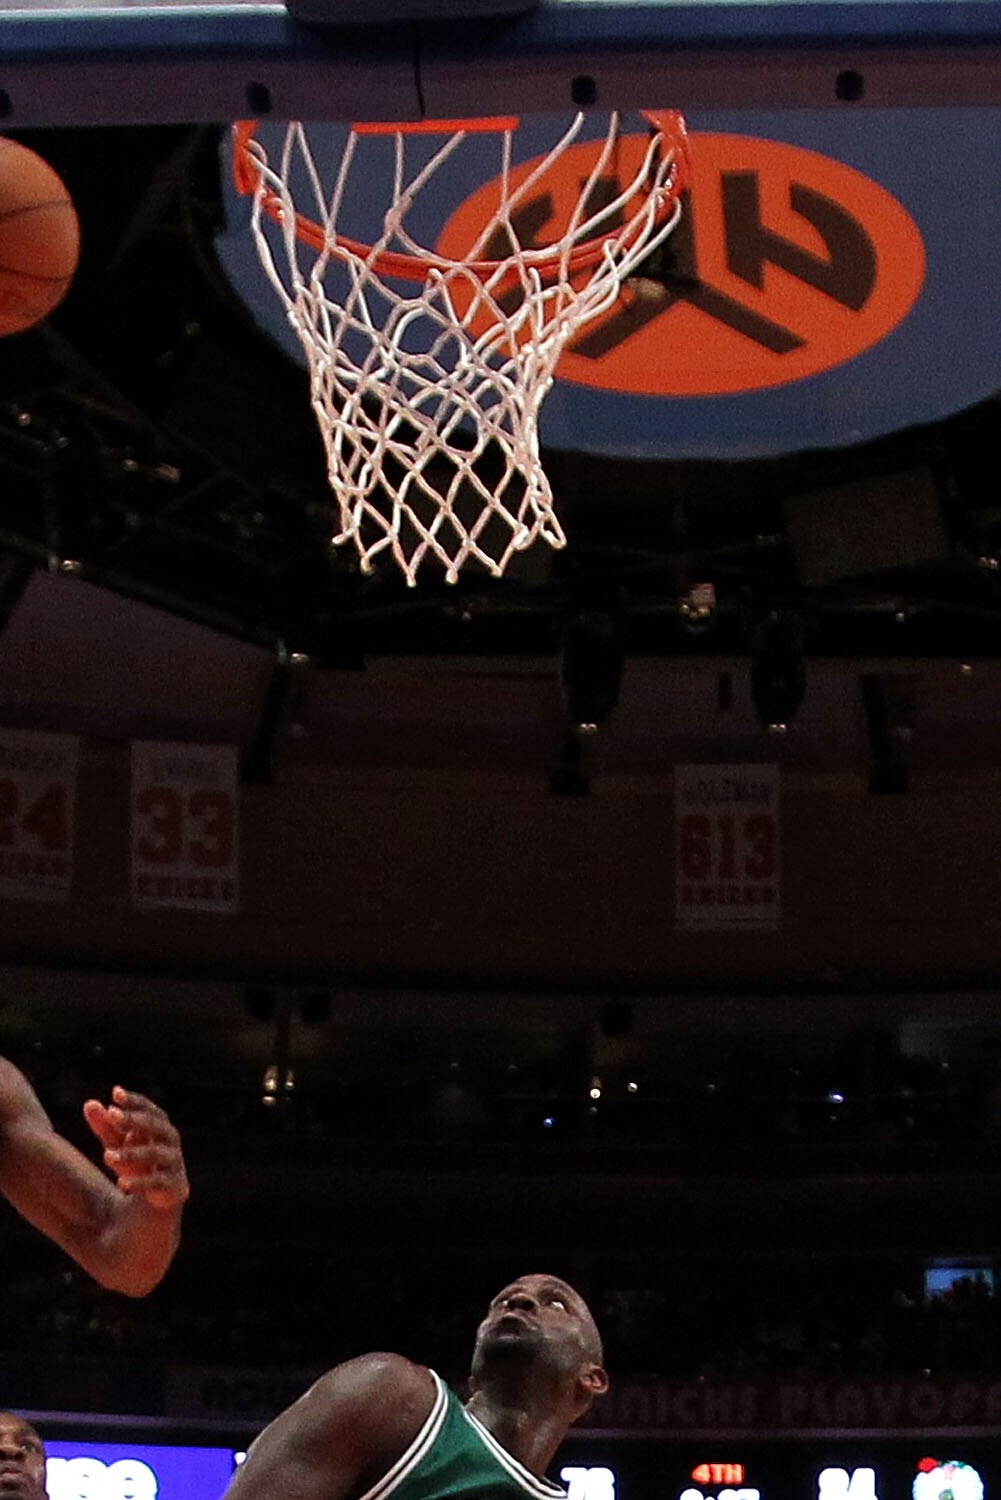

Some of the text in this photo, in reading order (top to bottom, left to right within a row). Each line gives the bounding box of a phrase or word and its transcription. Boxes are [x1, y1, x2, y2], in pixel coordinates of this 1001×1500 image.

[137, 785, 233, 867] 33
[680, 814, 776, 880] 613
[692, 1463, 745, 1485] 4TH
